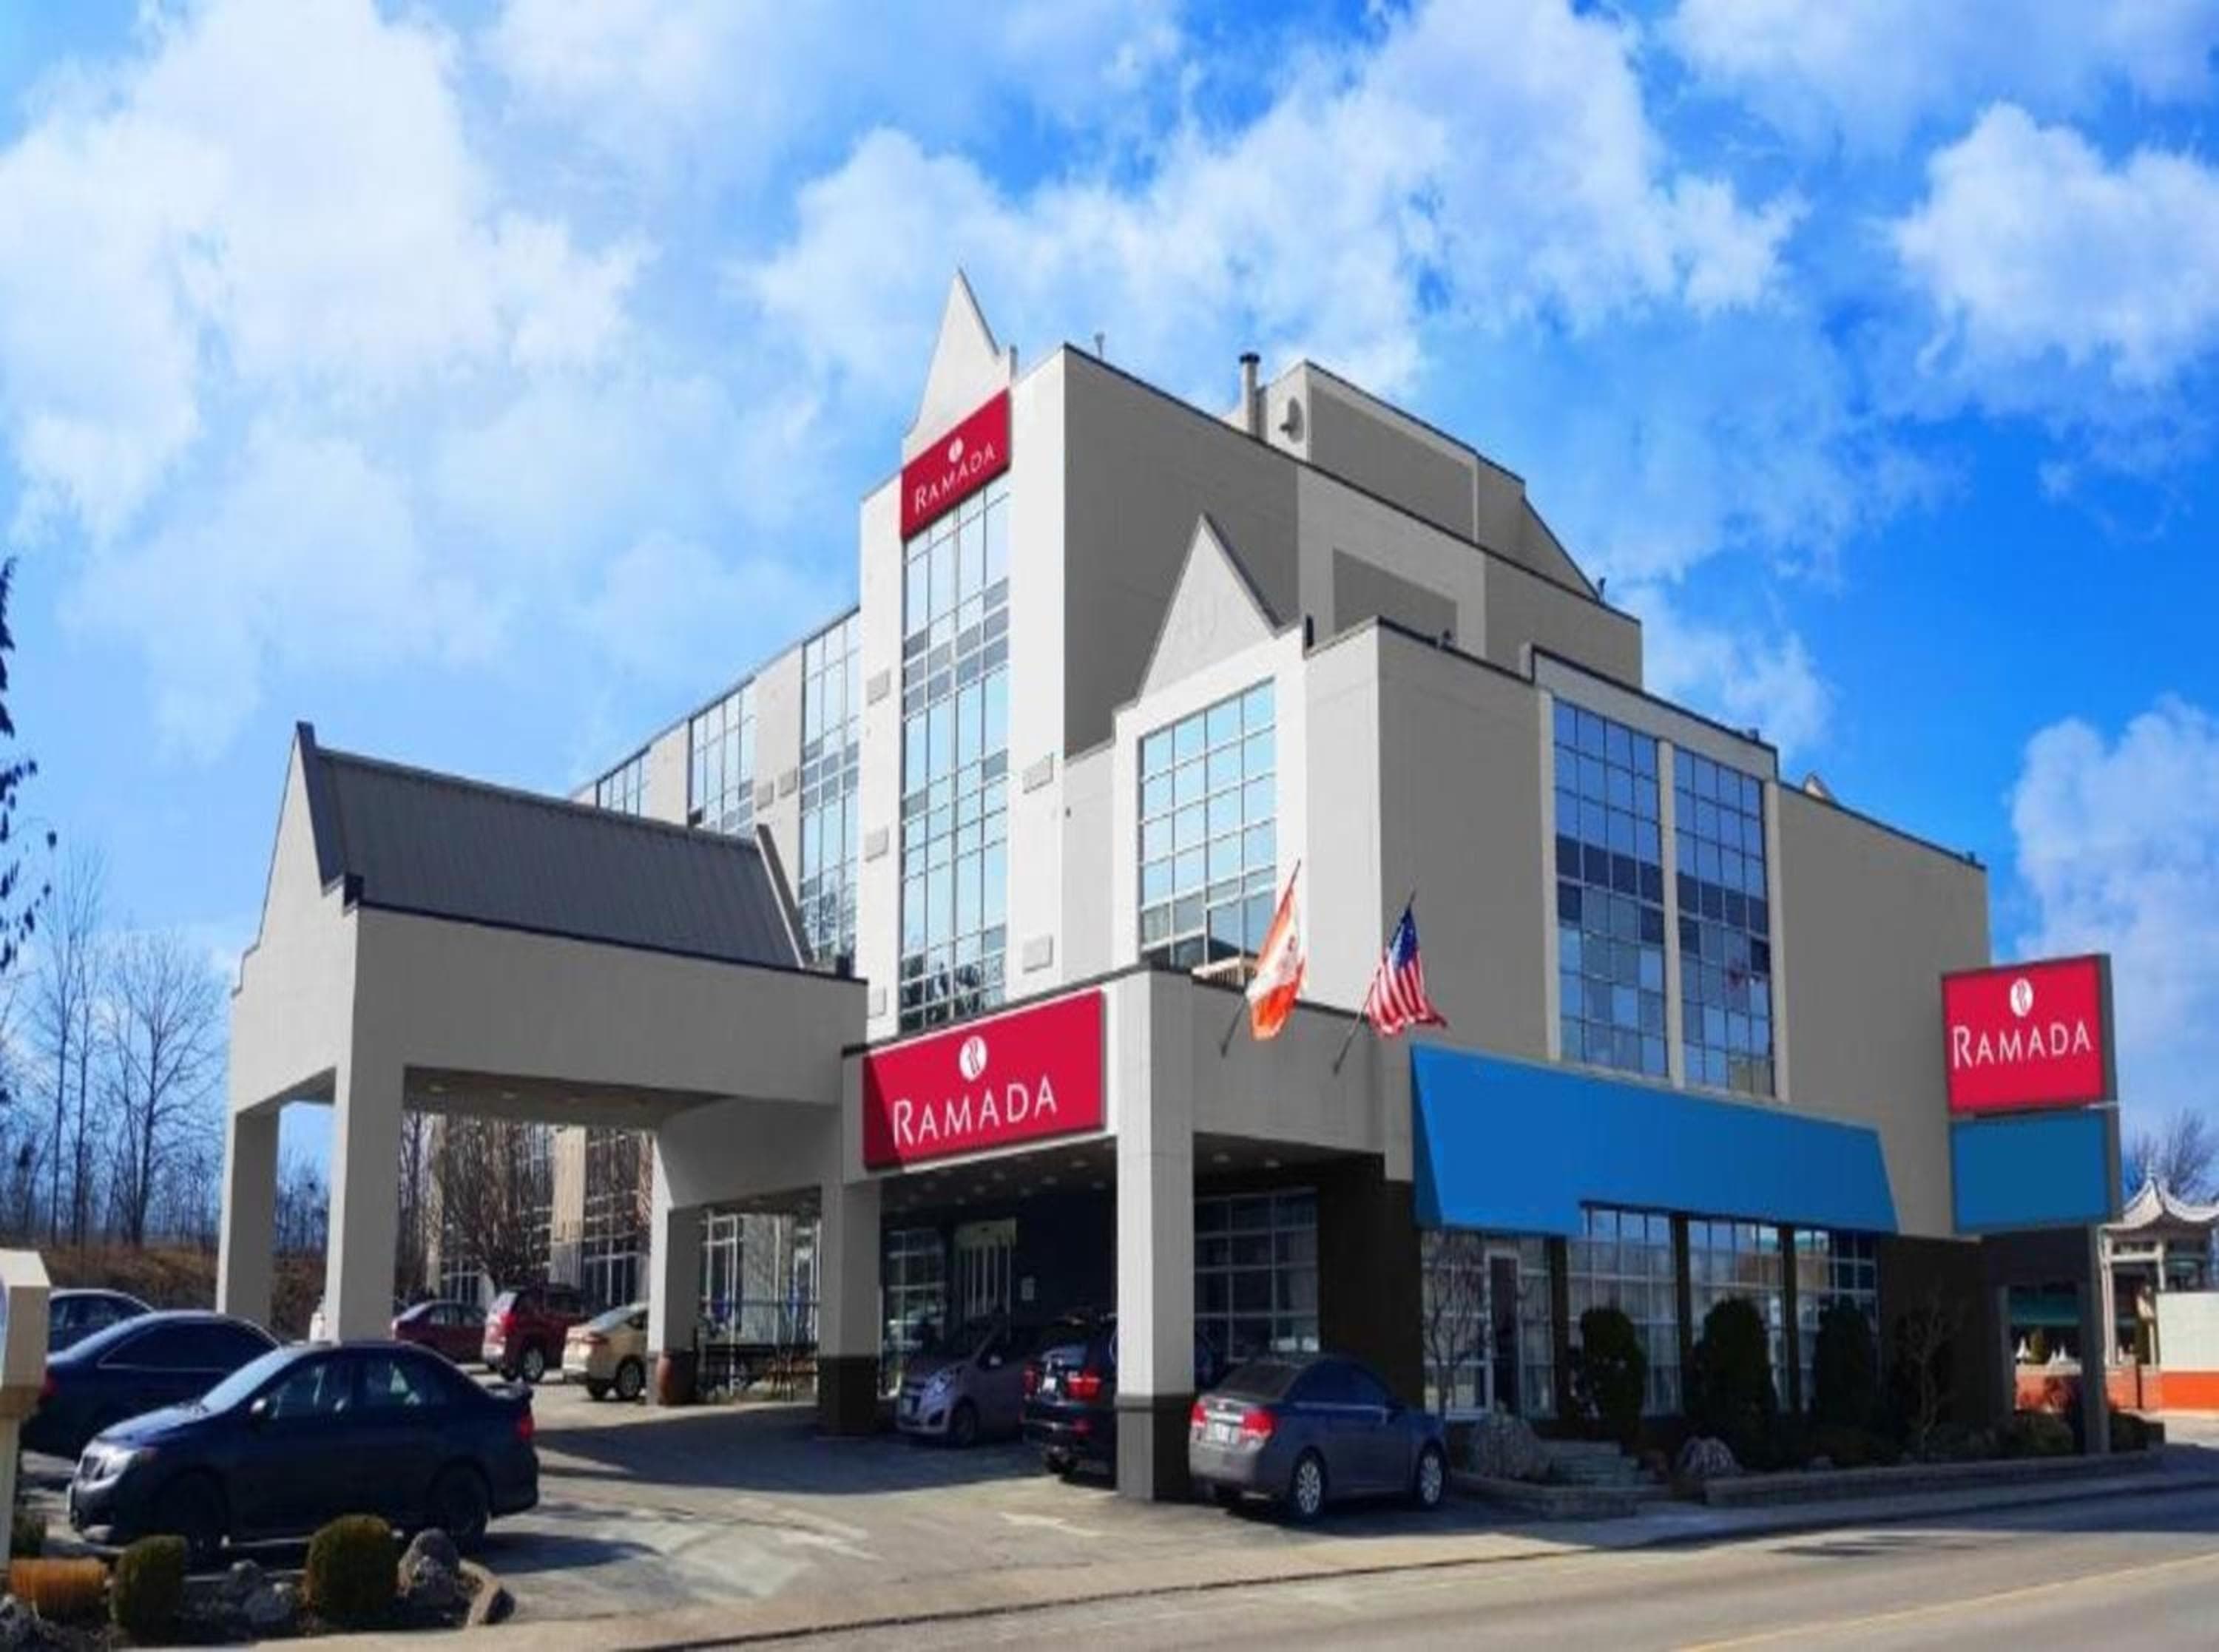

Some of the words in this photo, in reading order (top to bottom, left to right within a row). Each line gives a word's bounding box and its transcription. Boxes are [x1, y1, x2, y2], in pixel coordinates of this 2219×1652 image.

[914, 441, 996, 515] RAMADA
[1952, 1020, 2092, 1070] RAMADA
[893, 1073, 1058, 1149] RAMADA
